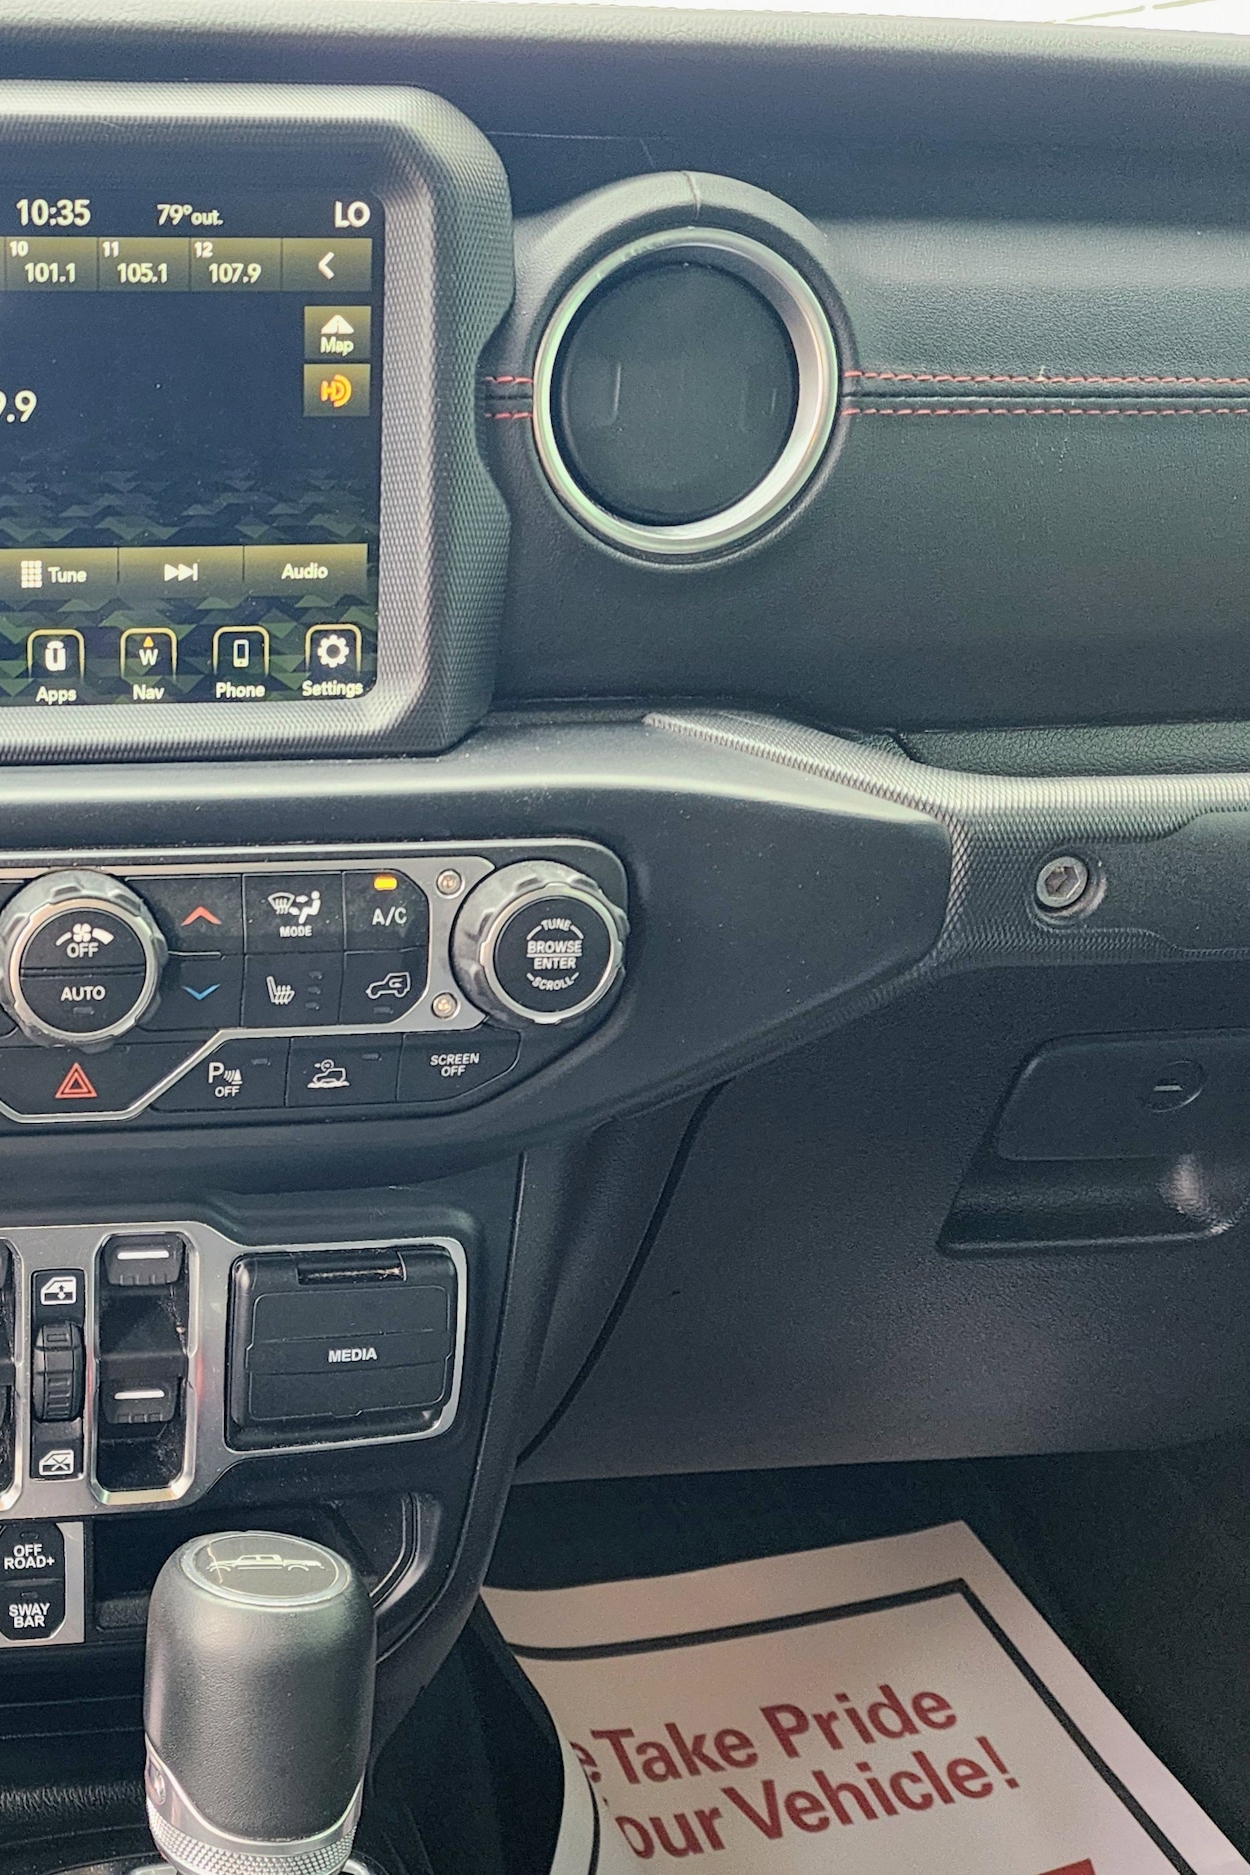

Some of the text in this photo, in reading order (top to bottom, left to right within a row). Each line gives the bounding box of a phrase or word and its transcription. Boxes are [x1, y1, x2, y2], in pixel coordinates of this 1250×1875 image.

[16, 198, 92, 228] 10:35
[333, 200, 371, 229] LO
[9, 240, 29, 257] 10
[102, 240, 120, 258] 11
[194, 241, 214, 258] 12
[24, 262, 77, 283] 101.1
[117, 262, 168, 284] 105.1
[208, 263, 262, 284] 107.9
[320, 337, 354, 357] Map
[48, 566, 88, 584] Tune
[281, 562, 329, 580] Audio
[139, 648, 159, 666] W
[35, 686, 77, 705] Apps
[133, 684, 165, 701] Nav
[215, 681, 266, 699] Phone
[302, 680, 364, 700] Settings
[371, 906, 408, 926] A/C
[540, 917, 572, 932] TUNE
[278, 925, 313, 938] MODE
[66, 941, 99, 959] OFF
[526, 940, 583, 954] BROWSE
[533, 957, 577, 970] ENTER
[531, 976, 575, 991] SCROLL
[60, 986, 106, 1002] AUTO
[430, 1052, 481, 1067] SCREEN
[208, 1061, 225, 1084] P
[440, 1066, 467, 1078] OFF
[214, 1085, 241, 1098] OFF
[327, 1347, 378, 1363] MEDIA
[13, 1544, 43, 1557] OFF
[3, 1554, 55, 1570] ROAD+
[8, 1602, 51, 1618] SWAY
[13, 1615, 46, 1629] BAR
[589, 1722, 756, 1786] Take
[759, 1683, 958, 1760] Pride
[602, 1735, 1021, 1860] our Vehicle!
